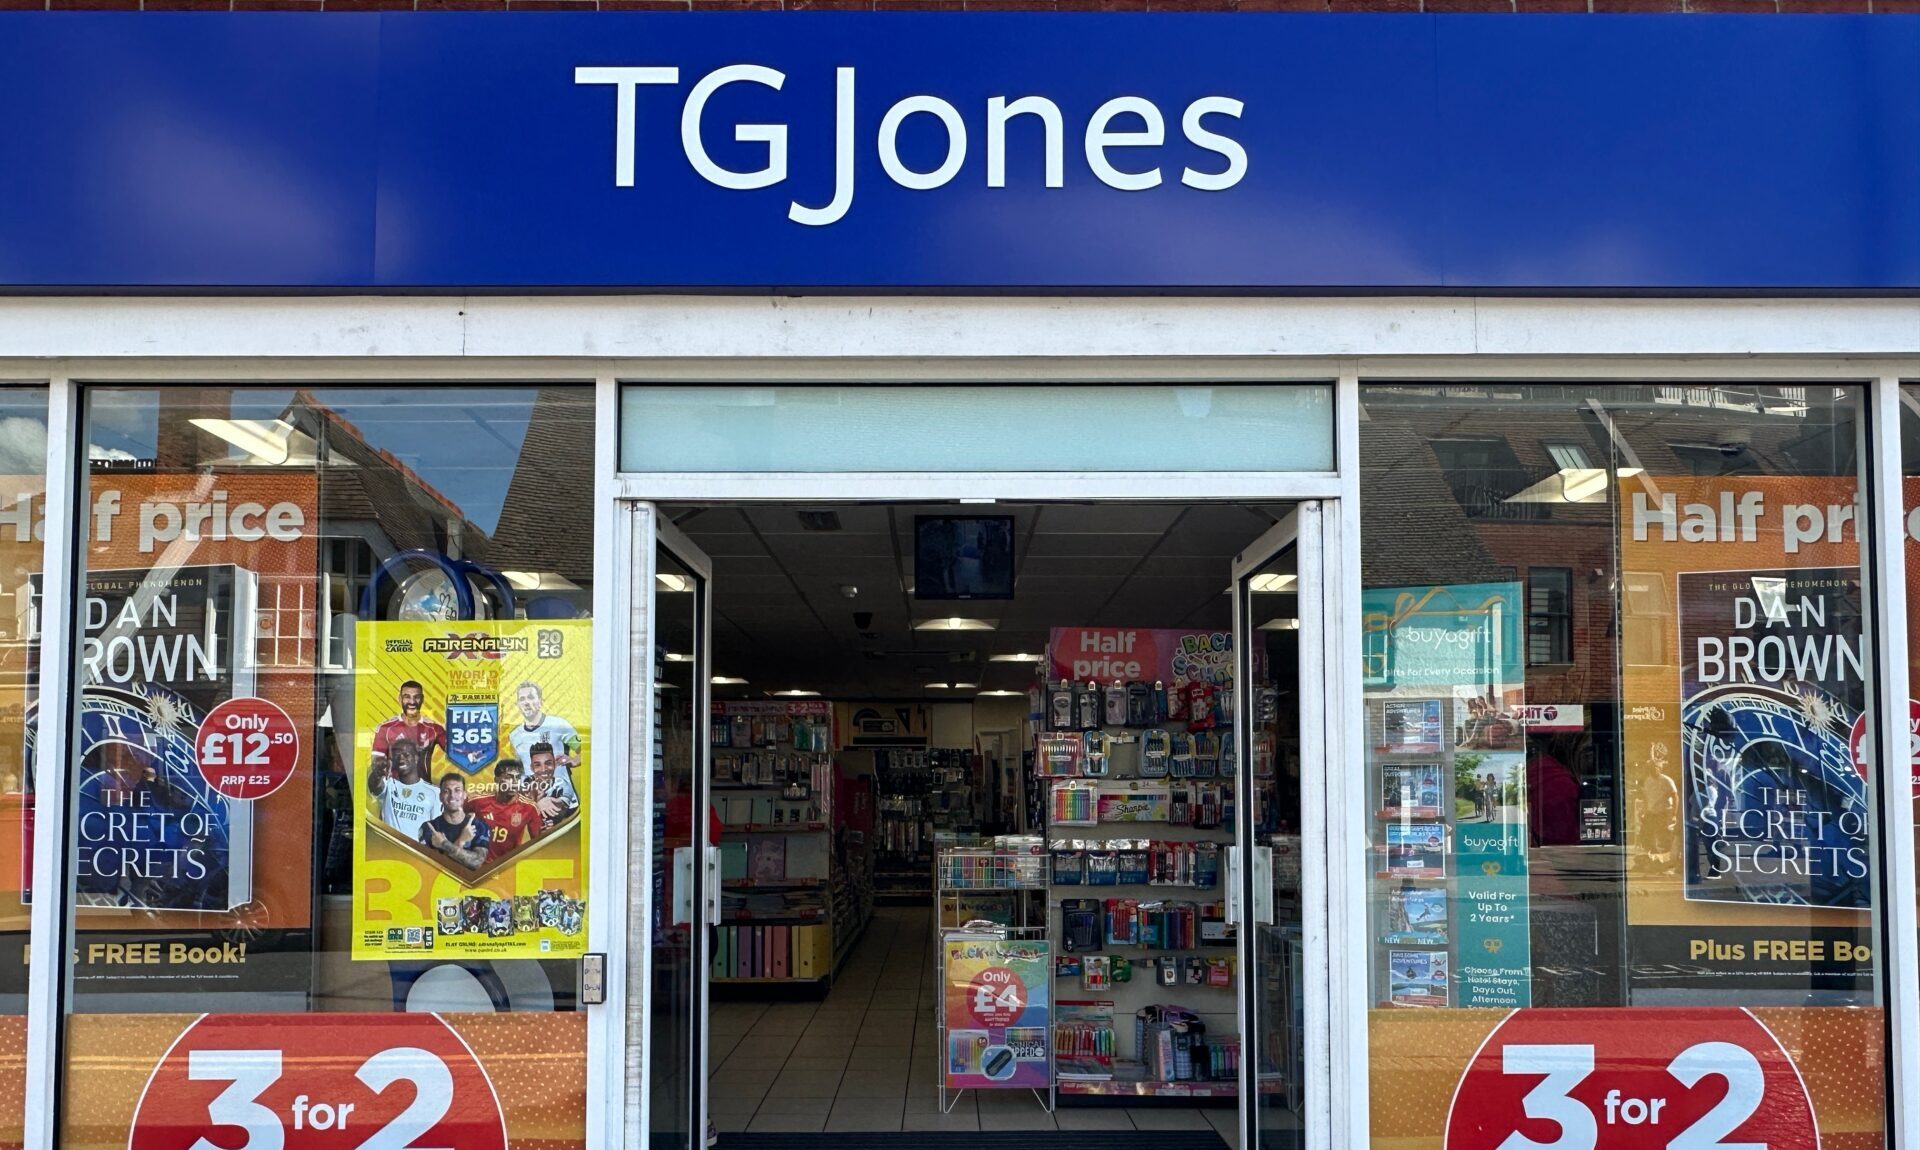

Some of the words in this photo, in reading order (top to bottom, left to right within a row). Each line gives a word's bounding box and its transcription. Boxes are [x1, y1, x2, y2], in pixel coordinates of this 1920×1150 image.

[0, 490, 121, 542] Hf
[139, 490, 304, 553] price
[1631, 491, 1764, 543] Half
[86, 594, 177, 630] DAN
[1735, 594, 1825, 629] DAN
[423, 637, 528, 652] ADRENALYN
[539, 630, 561, 643] 20
[1080, 631, 1136, 653] Half
[1407, 625, 1491, 650] buyagift
[83, 633, 217, 683] ROWN
[539, 643, 561, 657] 26
[1697, 634, 1864, 682] BROWN
[1073, 655, 1141, 680] price
[225, 714, 269, 732] Only
[452, 711, 492, 724] FIFA
[452, 728, 492, 744] 365
[221, 775, 244, 785] RRP
[248, 775, 270, 785] £25
[101, 789, 151, 807] THE
[1758, 787, 1807, 806] THE
[1115, 802, 1151, 815] Sharpie
[80, 811, 174, 843] CRET
[179, 811, 219, 843] OF
[1701, 809, 1832, 841] SECRET
[1464, 835, 1519, 850] buyagift
[76, 847, 206, 879] ECRETS
[1711, 840, 1868, 878] SECRETS
[1469, 891, 1496, 900] Valid
[1499, 891, 1516, 900] For
[1470, 914, 1476, 922] 2
[1477, 903, 1492, 913] Up
[1494, 903, 1507, 912] To
[88, 943, 161, 965] FREE
[168, 942, 246, 965] Book!
[1690, 939, 1745, 961] Plus
[1753, 940, 1825, 962] FREE
[983, 971, 1010, 983] Only
[1464, 966, 1498, 975] Choose
[1499, 967, 1523, 976] From
[973, 984, 1018, 1012] £4
[1472, 986, 1495, 995] Days
[1472, 995, 1517, 1004] Afternoon
[188, 1049, 285, 1150] 3
[291, 1095, 354, 1130] for
[355, 1047, 455, 1150] 2
[1495, 1044, 1598, 1150] 3
[1604, 1089, 1666, 1125] for
[1666, 1041, 1767, 1150] 2
